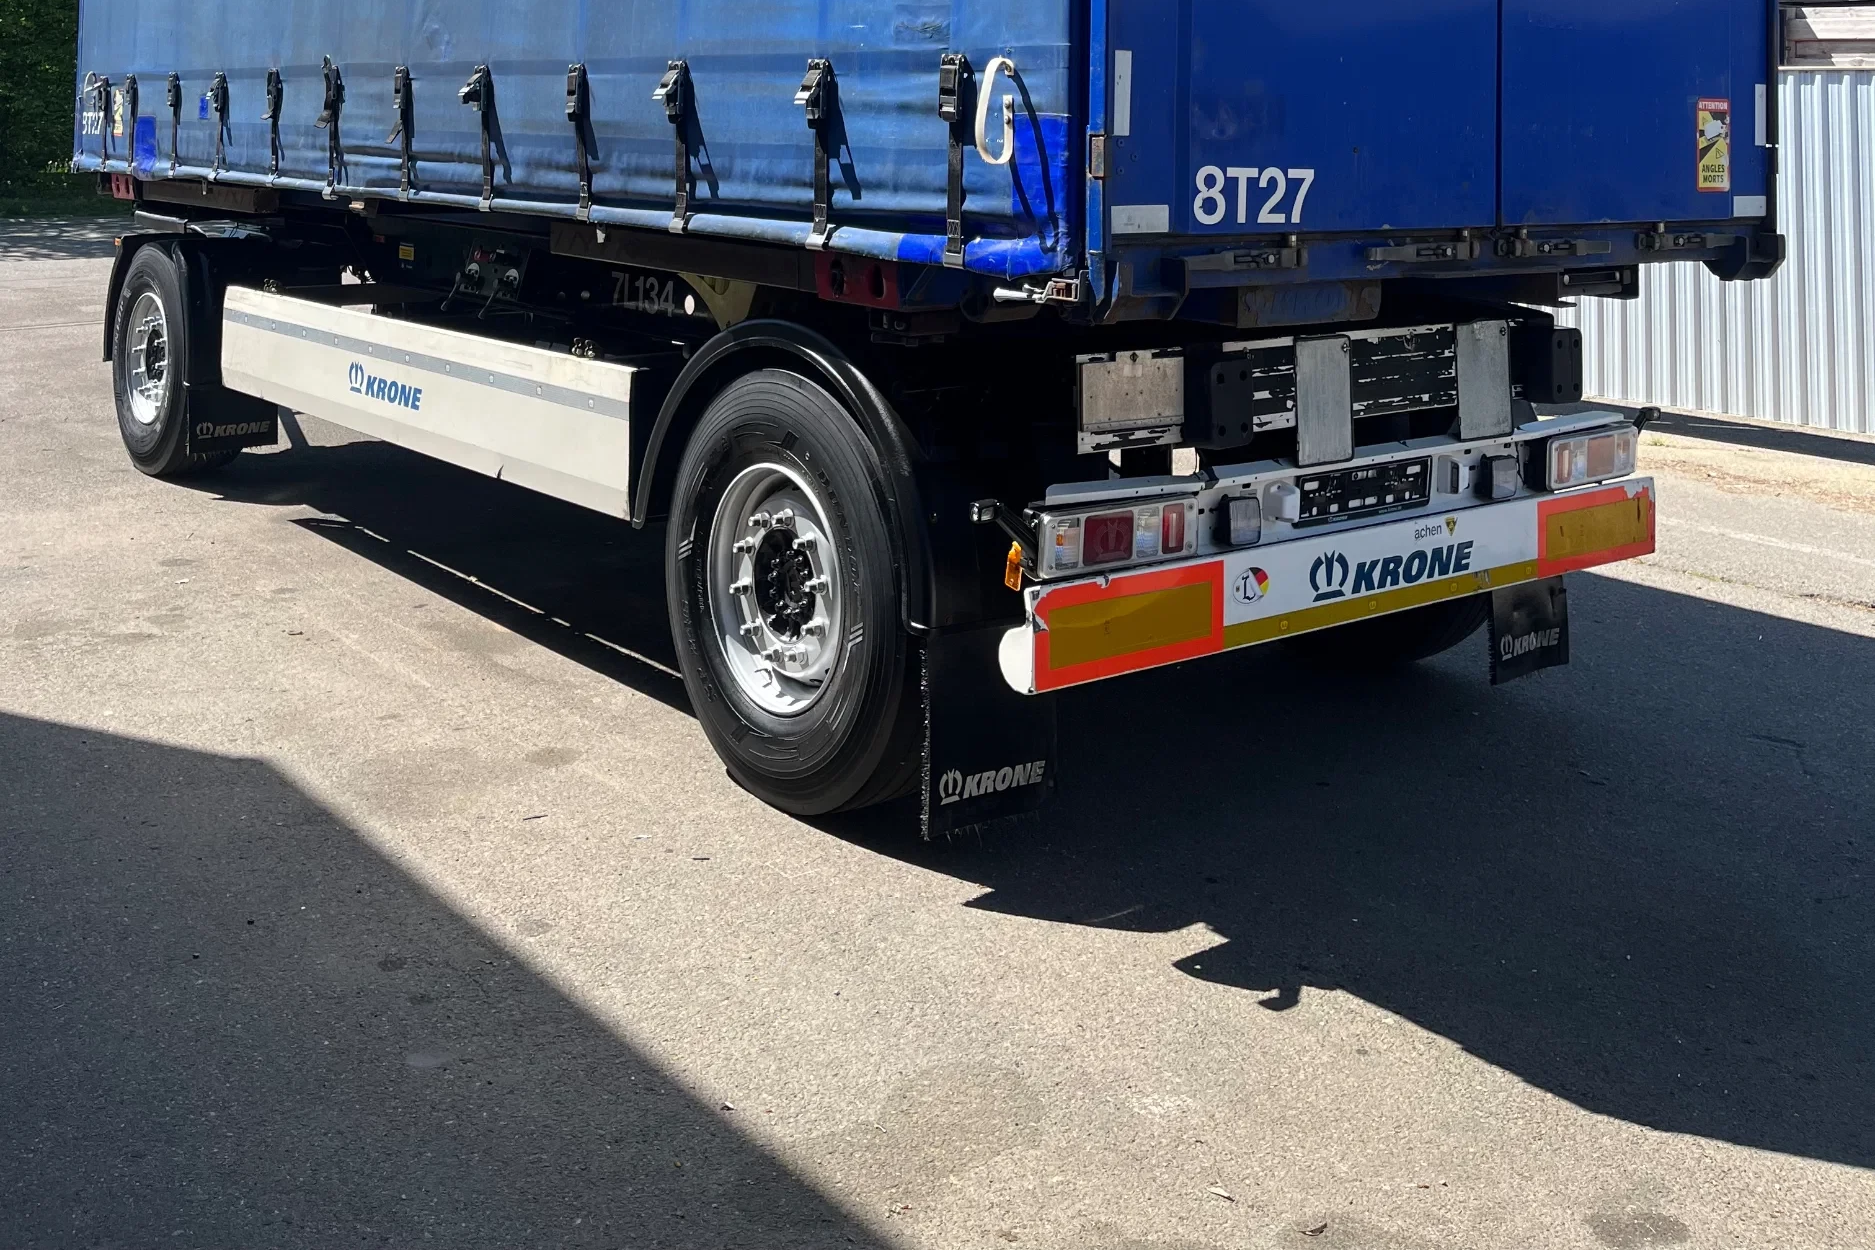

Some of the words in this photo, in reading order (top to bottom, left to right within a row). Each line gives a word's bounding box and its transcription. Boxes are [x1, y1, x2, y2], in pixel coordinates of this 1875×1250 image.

[1699, 102, 1728, 110] ATTENTION
[1702, 164, 1725, 173] ANGLES
[1703, 174, 1724, 183] MORTS
[1193, 165, 1315, 225] 8T27
[611, 271, 675, 317] 7L134
[365, 374, 423, 411] KRONE
[213, 420, 271, 438] KRONE
[1351, 539, 1474, 595] KRONE
[1513, 627, 1560, 657] KRONE
[962, 760, 1046, 799] KRONE
